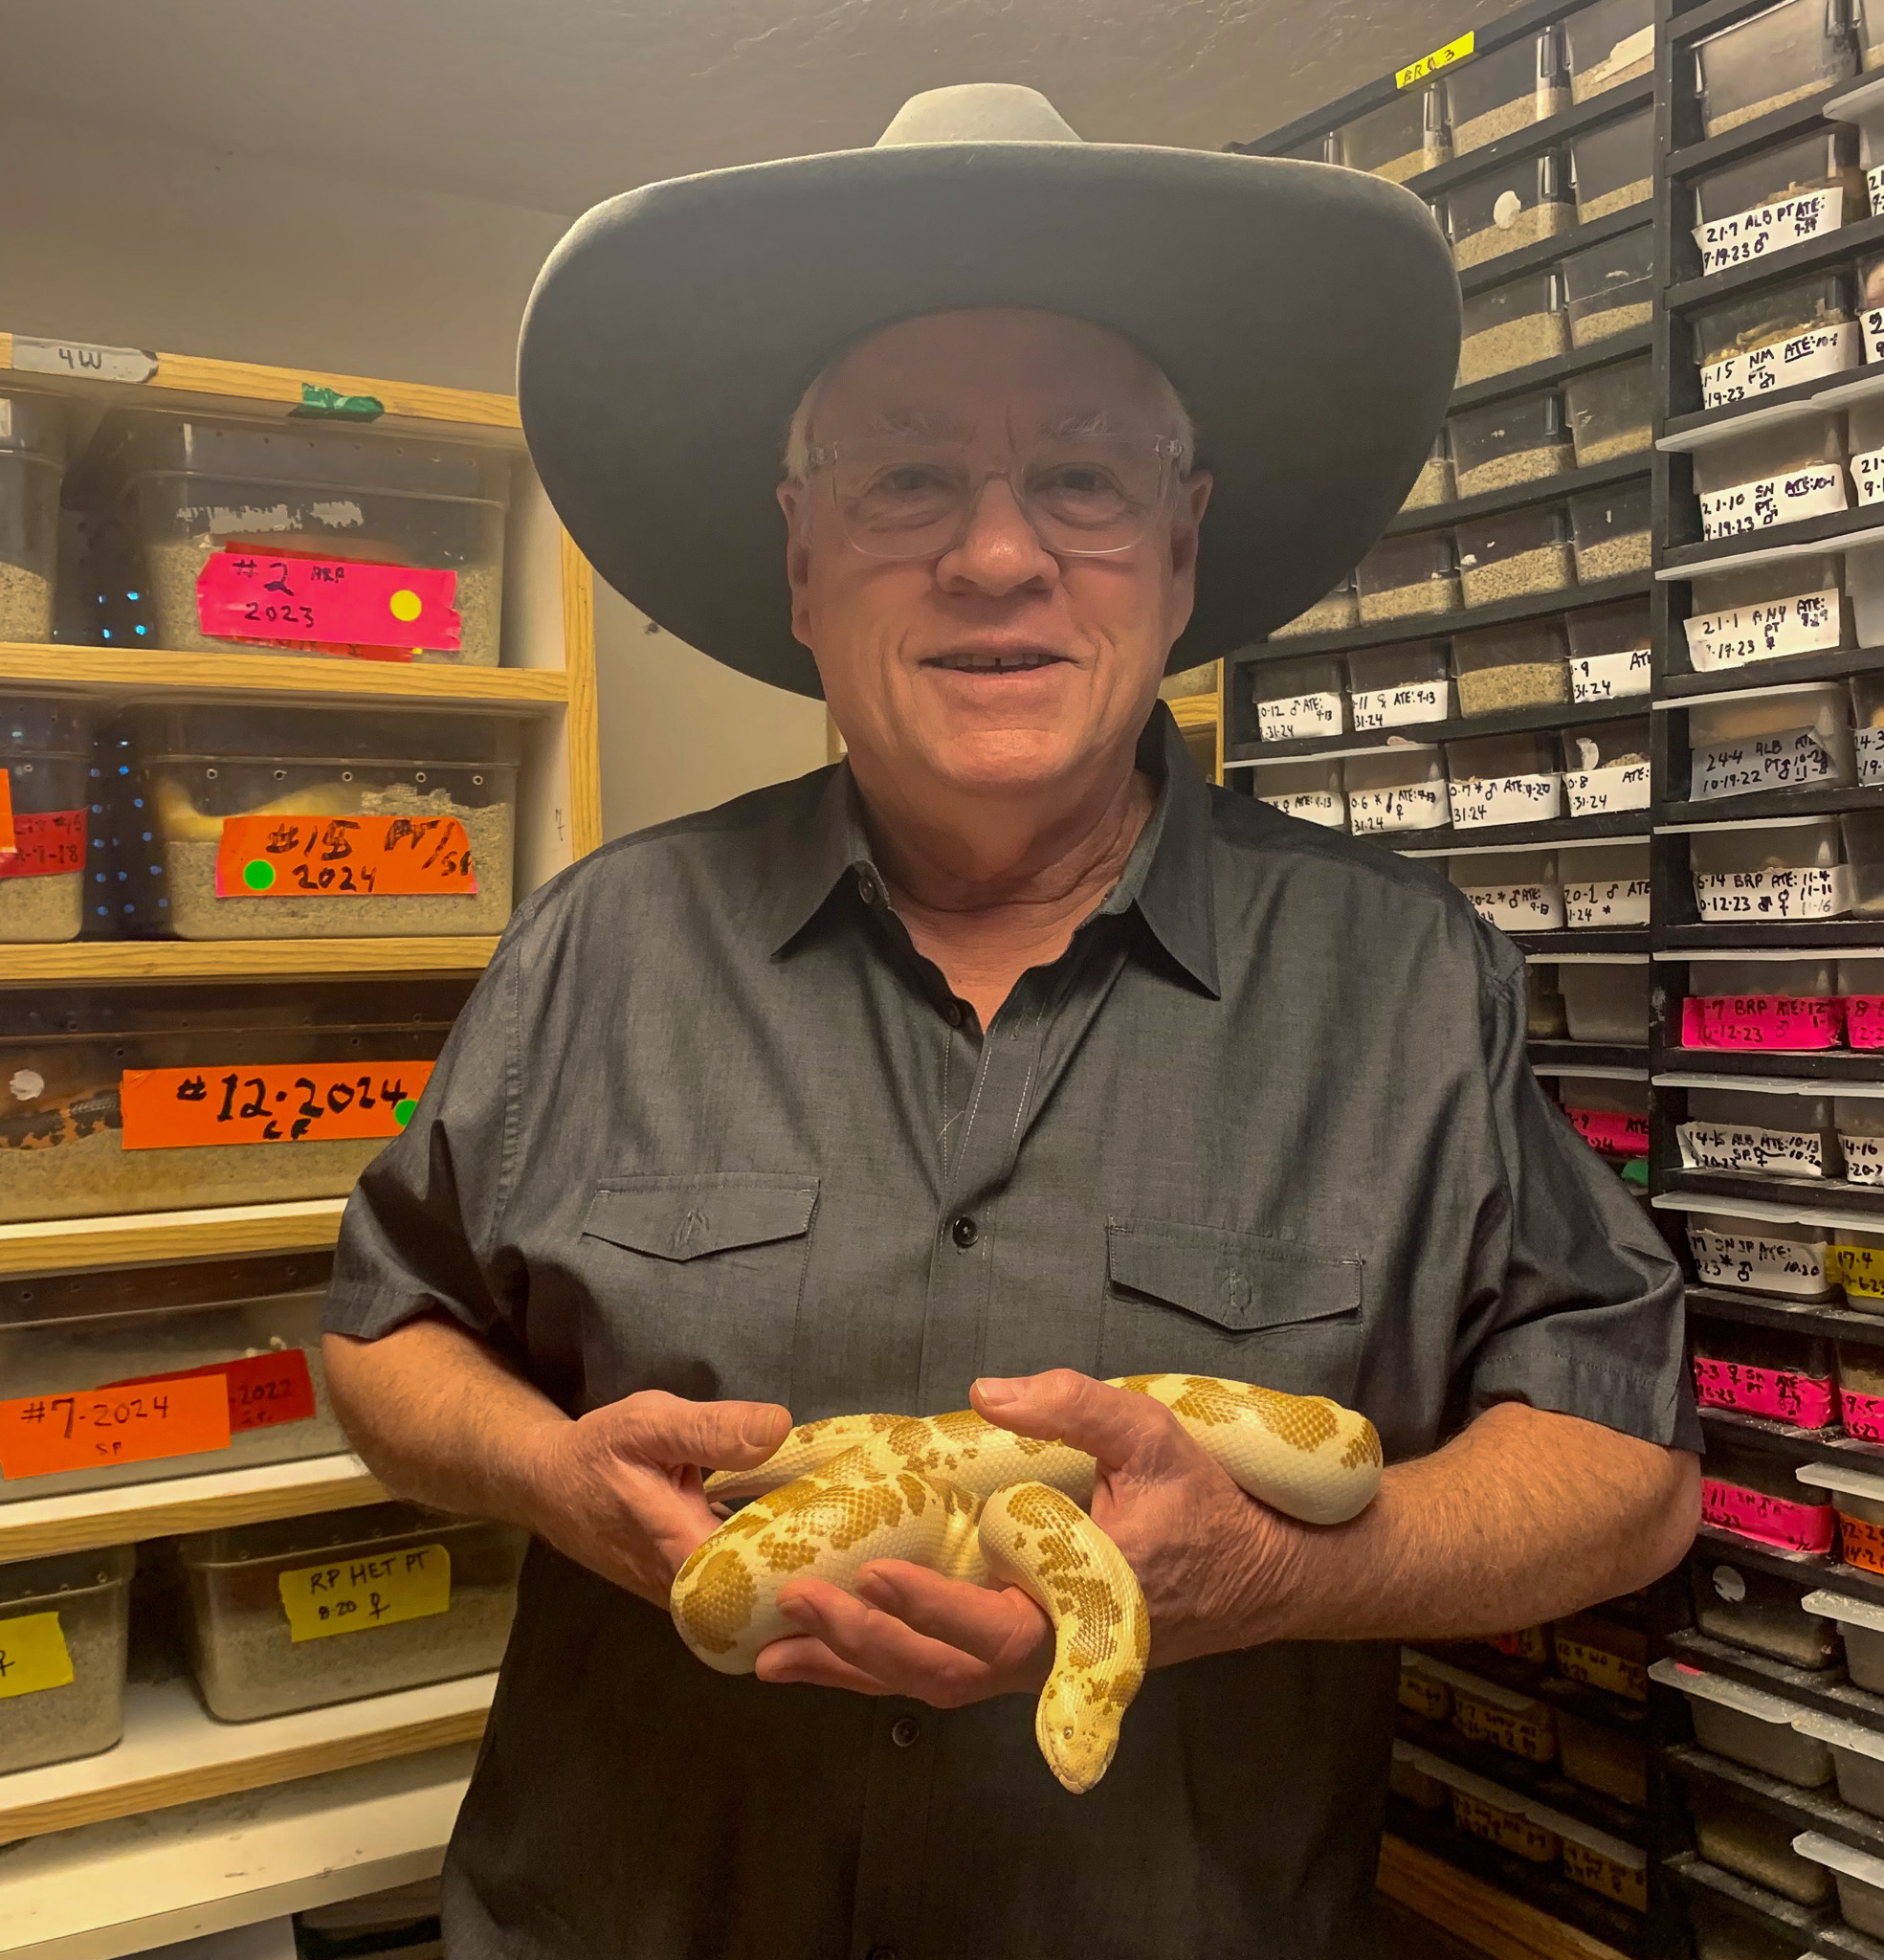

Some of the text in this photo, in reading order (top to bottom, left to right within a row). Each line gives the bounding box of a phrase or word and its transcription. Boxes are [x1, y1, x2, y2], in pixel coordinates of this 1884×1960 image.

[1444, 49, 1455, 61] 3
[244, 601, 315, 628] 2023
[292, 863, 377, 892] 2024
[1734, 874, 1763, 889] BRP
[1734, 999, 1768, 1016] BRP
[309, 1549, 431, 1595] RP HET PT
